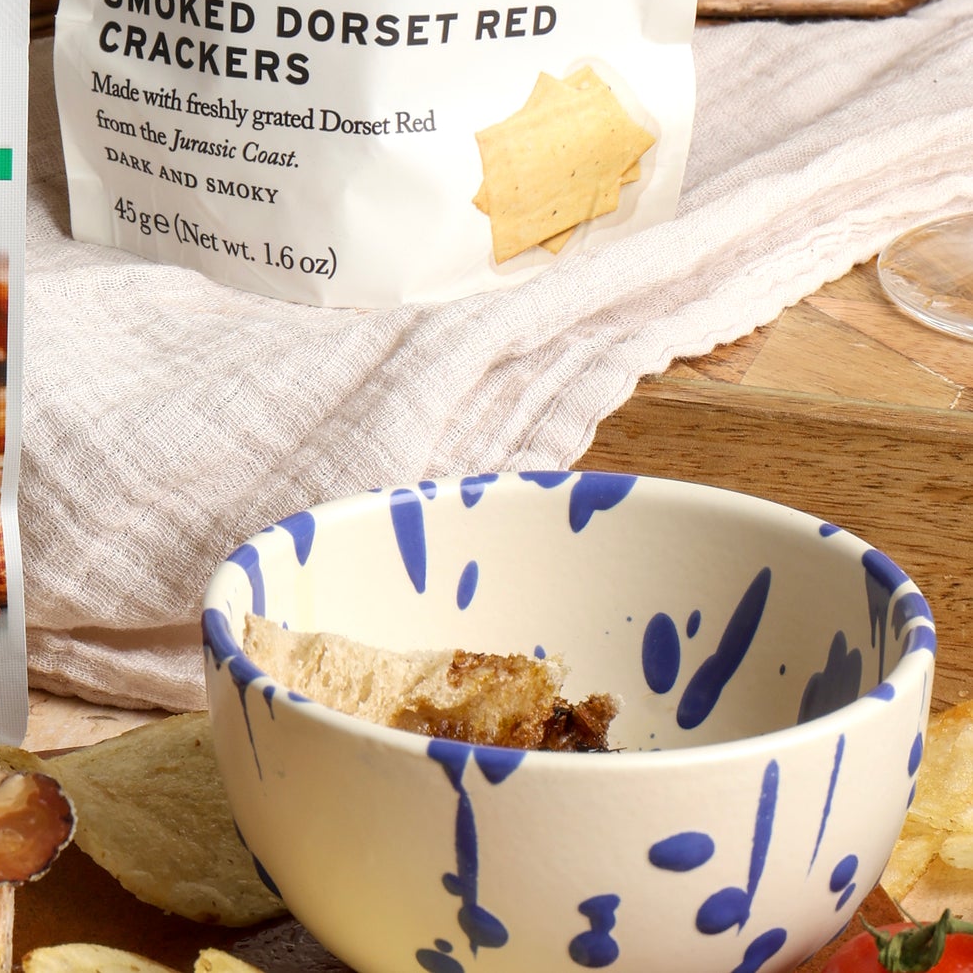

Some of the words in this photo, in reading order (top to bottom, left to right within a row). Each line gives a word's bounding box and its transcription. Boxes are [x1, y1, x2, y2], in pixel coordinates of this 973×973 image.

[98, 20, 311, 85] CRACKERS
[276, 5, 459, 47] DORSET
[474, 5, 557, 41] RED
[91, 71, 140, 102] Made
[143, 87, 182, 112] with
[186, 92, 249, 128] freshly
[252, 108, 315, 131] grated
[319, 109, 391, 136] Dorset
[395, 109, 437, 134] Red
[96, 108, 138, 138] from
[139, 121, 167, 146] the
[168, 128, 237, 159] Jurassic
[243, 141, 299, 168] Coast.
[104, 146, 154, 176] DARK
[158, 165, 198, 189] AND
[206, 177, 279, 204] SMOKY
[174, 212, 220, 253] (Net
[222, 238, 256, 262] wt.
[263, 242, 295, 270] 1.6
[299, 246, 338, 280] oz)
